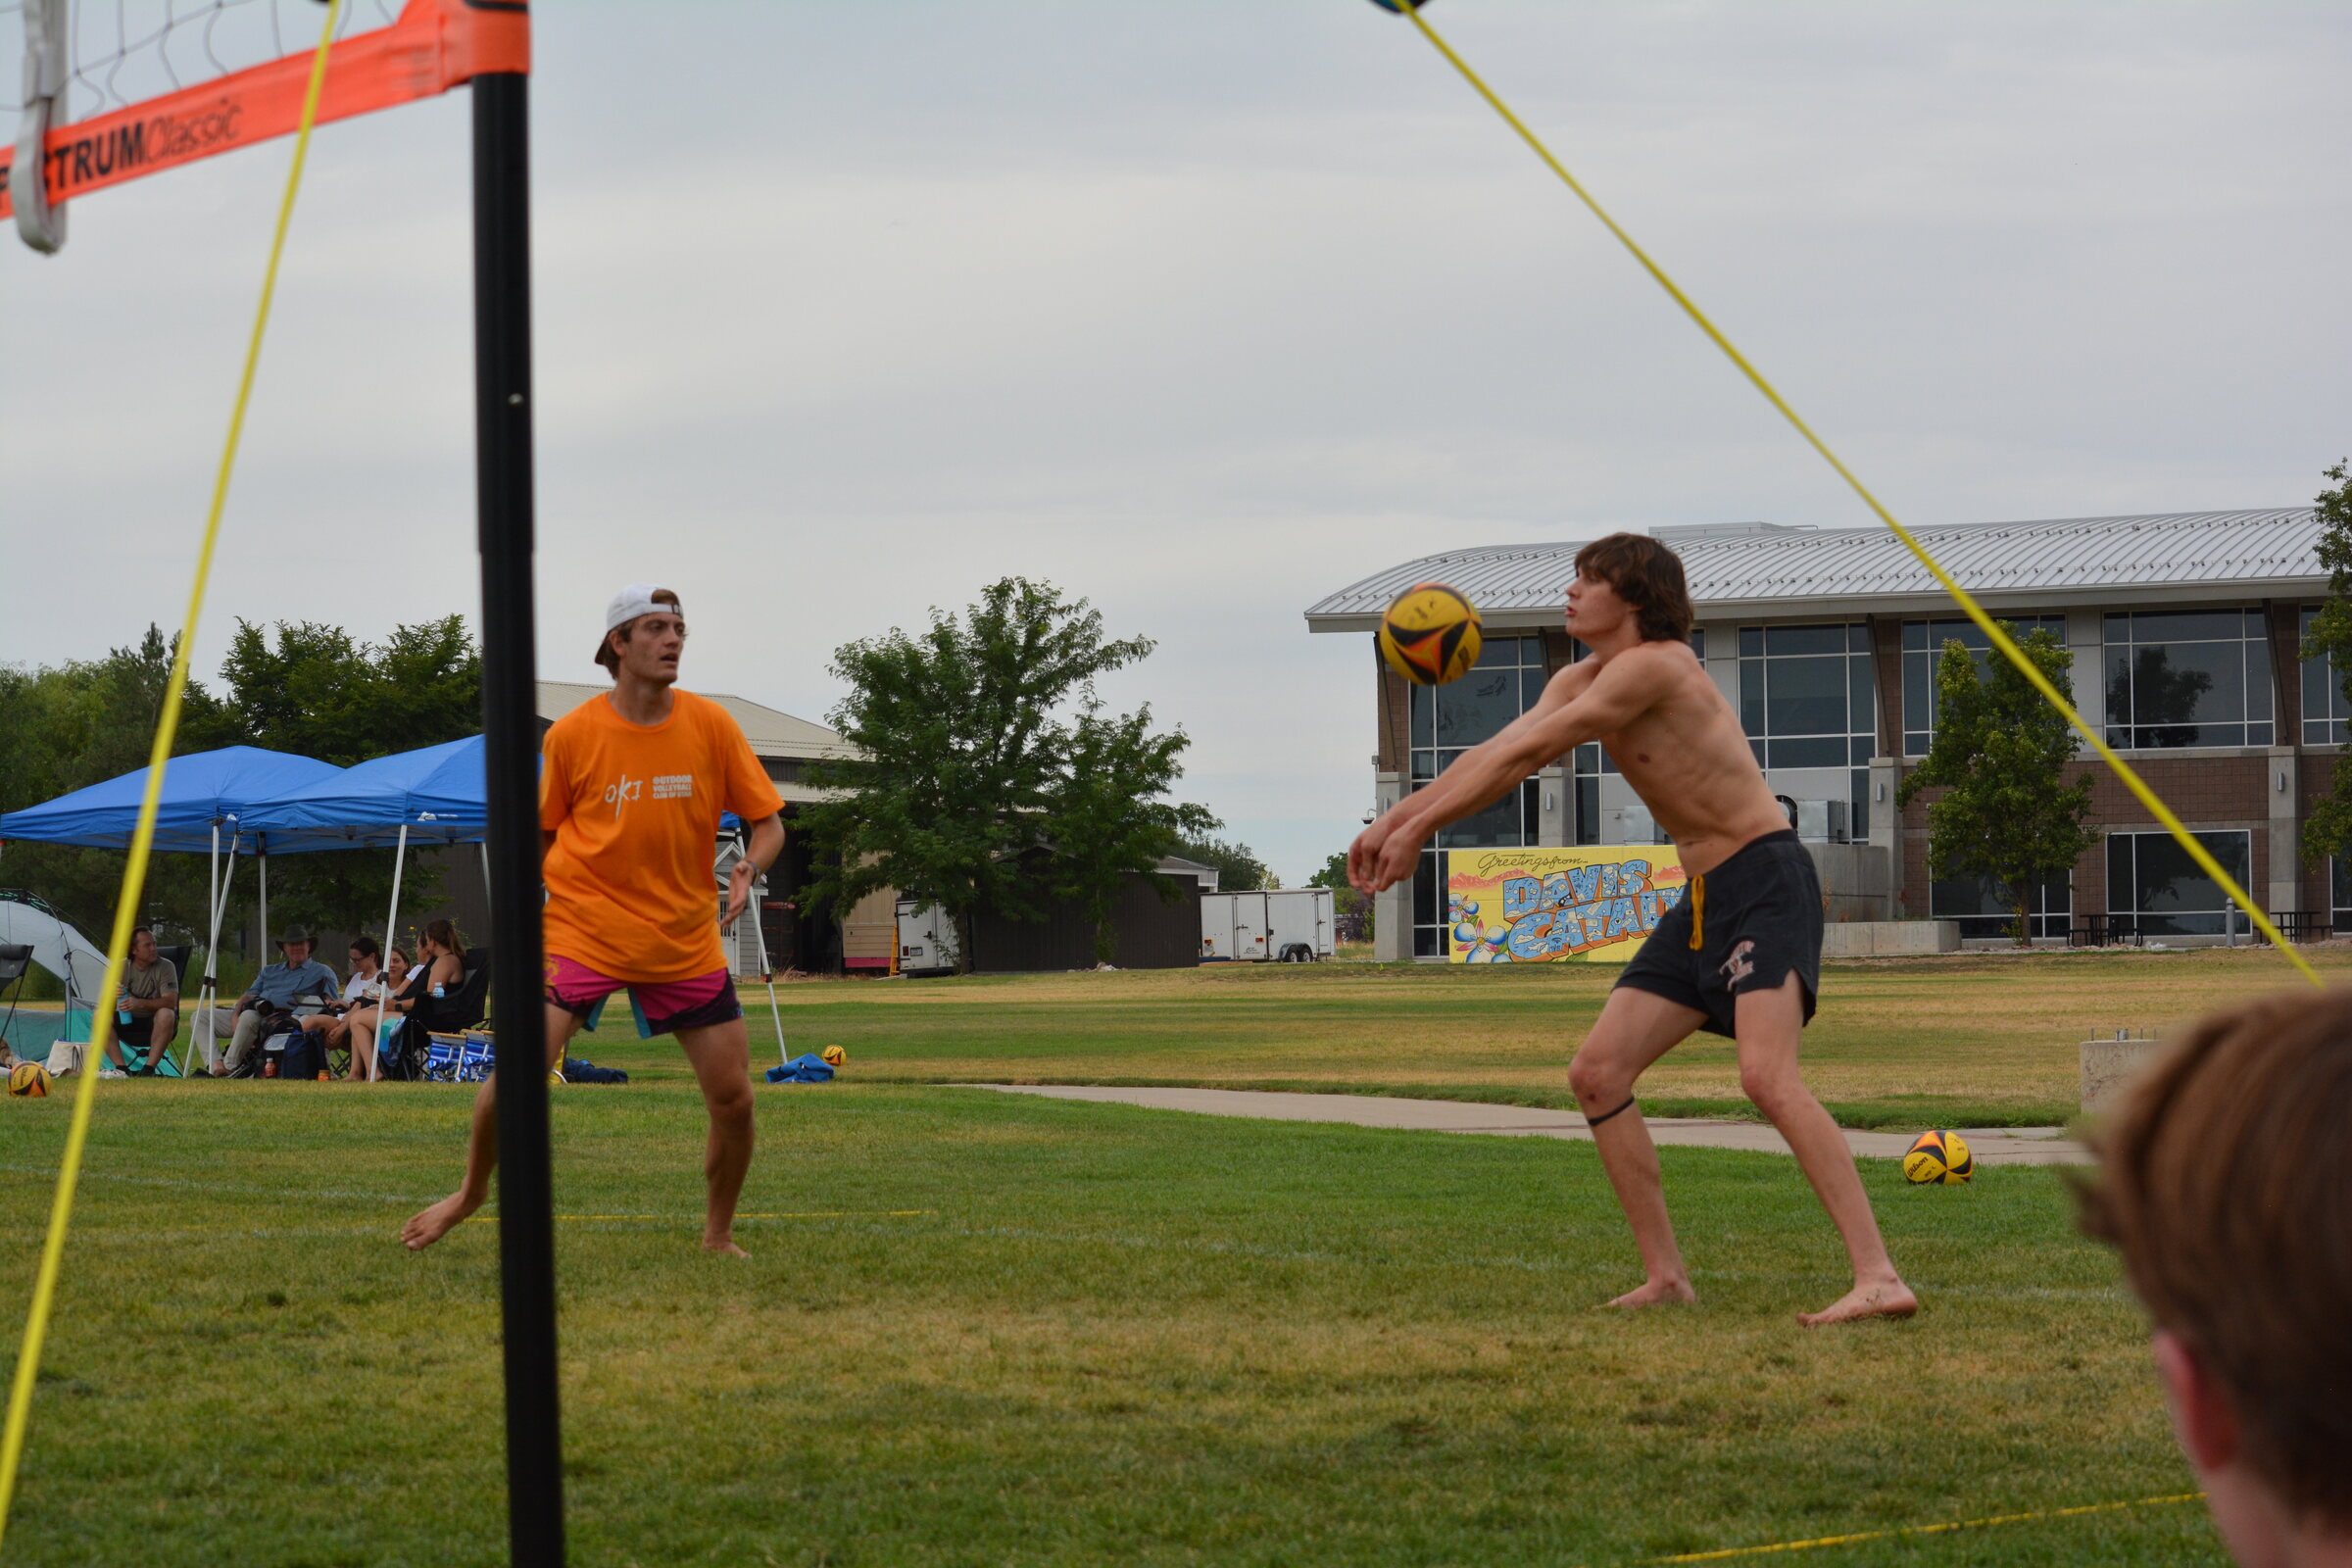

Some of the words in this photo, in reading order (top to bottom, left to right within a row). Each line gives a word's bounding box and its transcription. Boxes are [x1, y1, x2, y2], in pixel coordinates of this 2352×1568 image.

[145, 98, 242, 163] Classic
[653, 775, 693, 785] OUTDOOR
[1478, 853, 1549, 877] Greetings
[1503, 859, 1654, 924] DAVIS
[1907, 1156, 1929, 1177] Wilson
